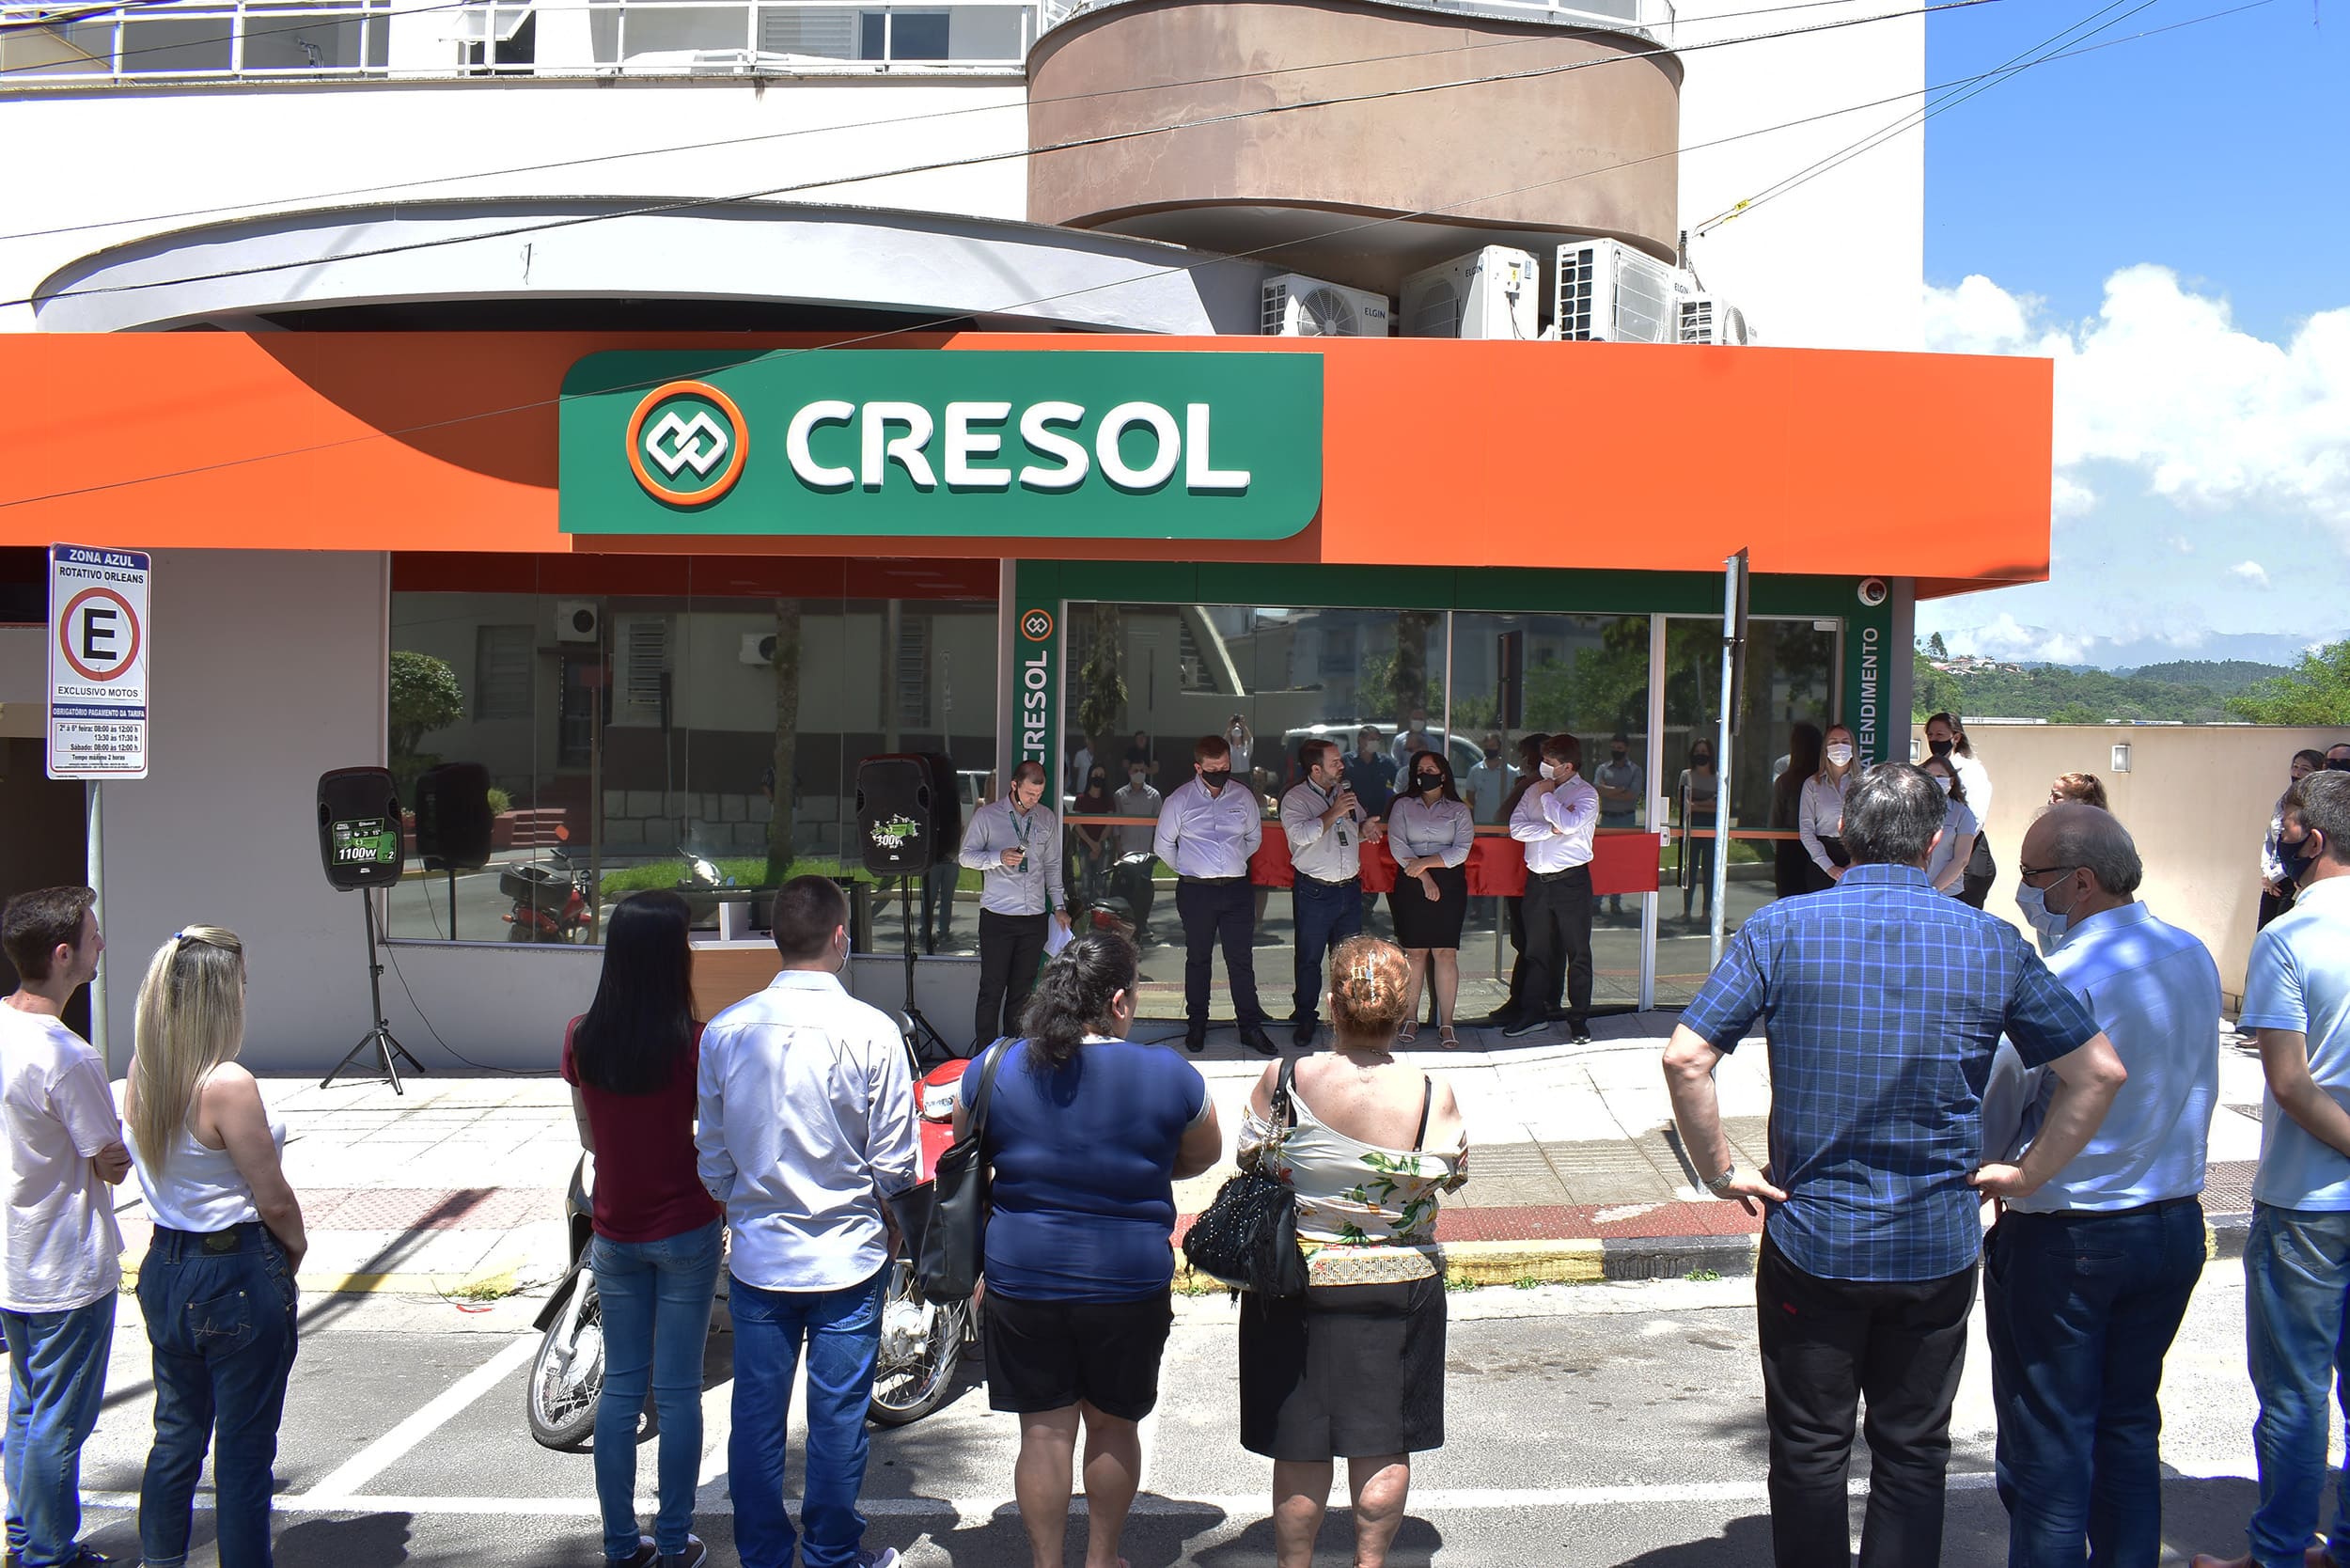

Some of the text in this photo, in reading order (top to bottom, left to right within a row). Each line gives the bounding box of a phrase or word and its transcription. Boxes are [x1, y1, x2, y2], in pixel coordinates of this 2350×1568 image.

[1465, 264, 1483, 277] ELGIN
[1364, 306, 1386, 319] ELGIN
[786, 399, 1252, 489] CRESOL
[70, 549, 134, 568] ZONA AZUL
[59, 566, 144, 585] ROTATIVO ORLEANS
[83, 607, 118, 661] E
[57, 686, 139, 698] EXCLUSIVO MOTOS
[94, 733, 110, 742] 13:30
